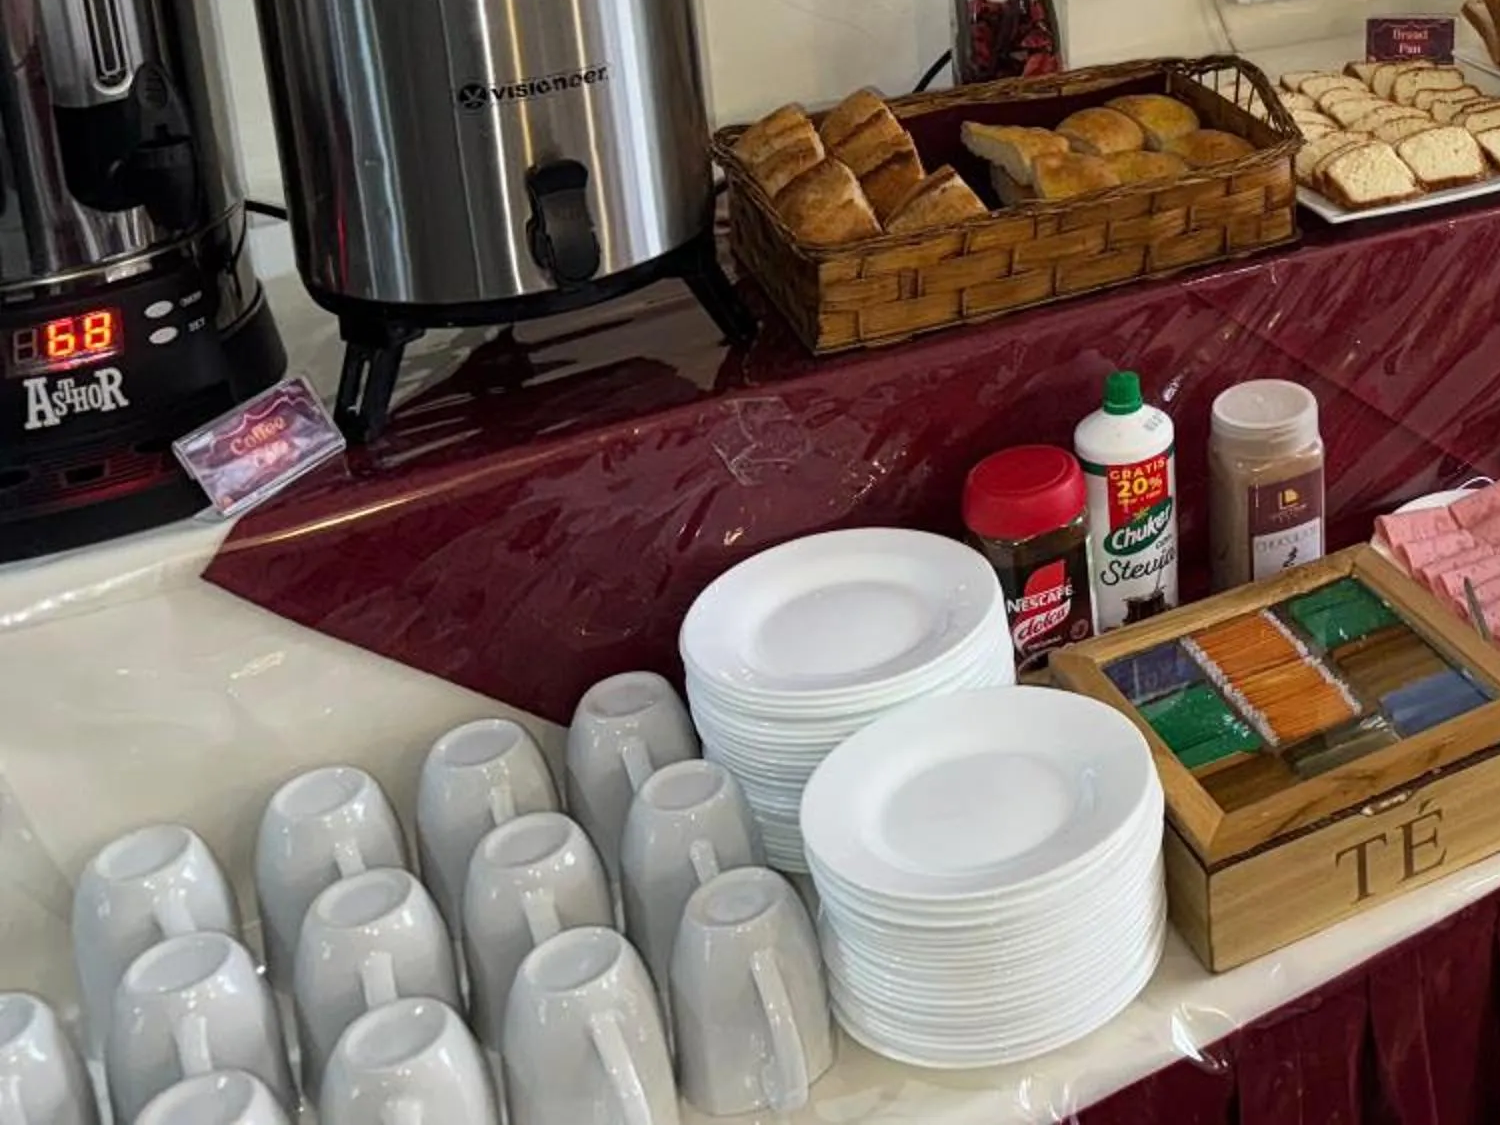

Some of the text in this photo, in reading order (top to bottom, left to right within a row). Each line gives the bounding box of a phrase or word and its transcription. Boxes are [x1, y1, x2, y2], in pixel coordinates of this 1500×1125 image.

[47, 310, 113, 358] 68
[1109, 457, 1165, 480] GRATIS
[1117, 474, 1163, 498] 20%
[1100, 546, 1176, 586] Stevia
[1006, 577, 1073, 614] NESCAFÉ
[1334, 796, 1448, 906] TÉ
